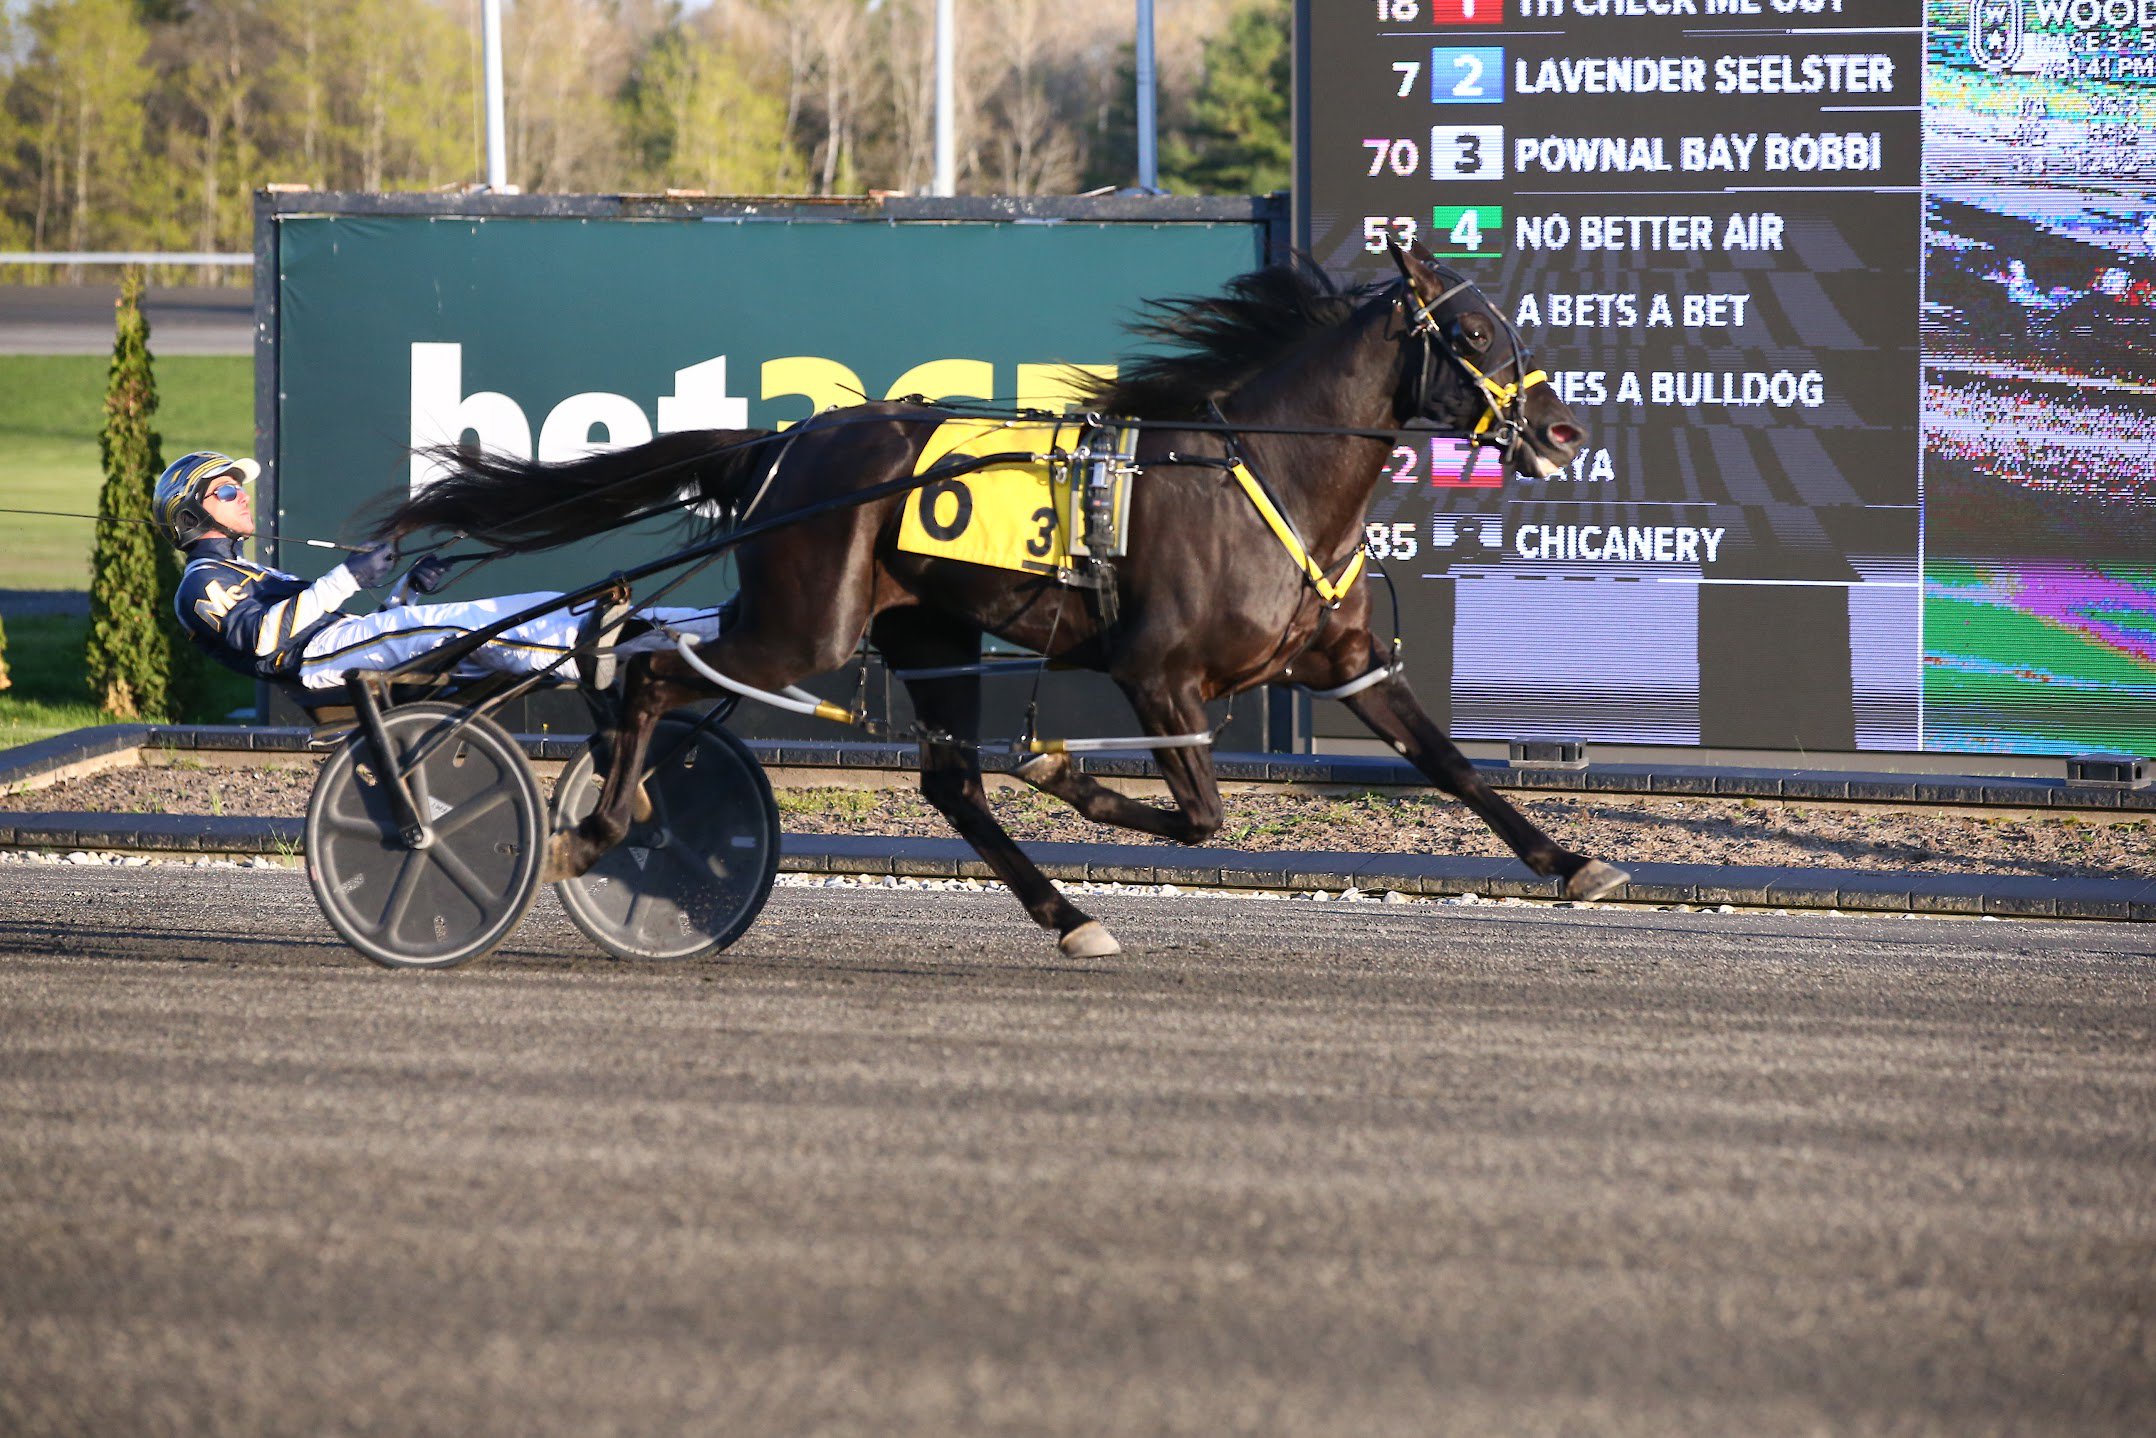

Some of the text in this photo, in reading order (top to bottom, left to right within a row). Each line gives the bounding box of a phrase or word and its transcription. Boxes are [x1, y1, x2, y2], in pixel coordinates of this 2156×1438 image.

[1392, 54, 1896, 97] 7 2 LAVENDER SEELSTER
[1362, 133, 1882, 177] 70 3 POWNAL BAY BOBBI
[1363, 209, 1785, 255] 53 4 NO BETTER AIR
[1516, 293, 1751, 328] A BETS A BET
[1616, 371, 1644, 406] A
[1651, 369, 1825, 407] BULLDOG
[1026, 506, 1057, 557] 3
[1364, 522, 1418, 561] 85
[1515, 524, 1726, 562] CHICANERY
